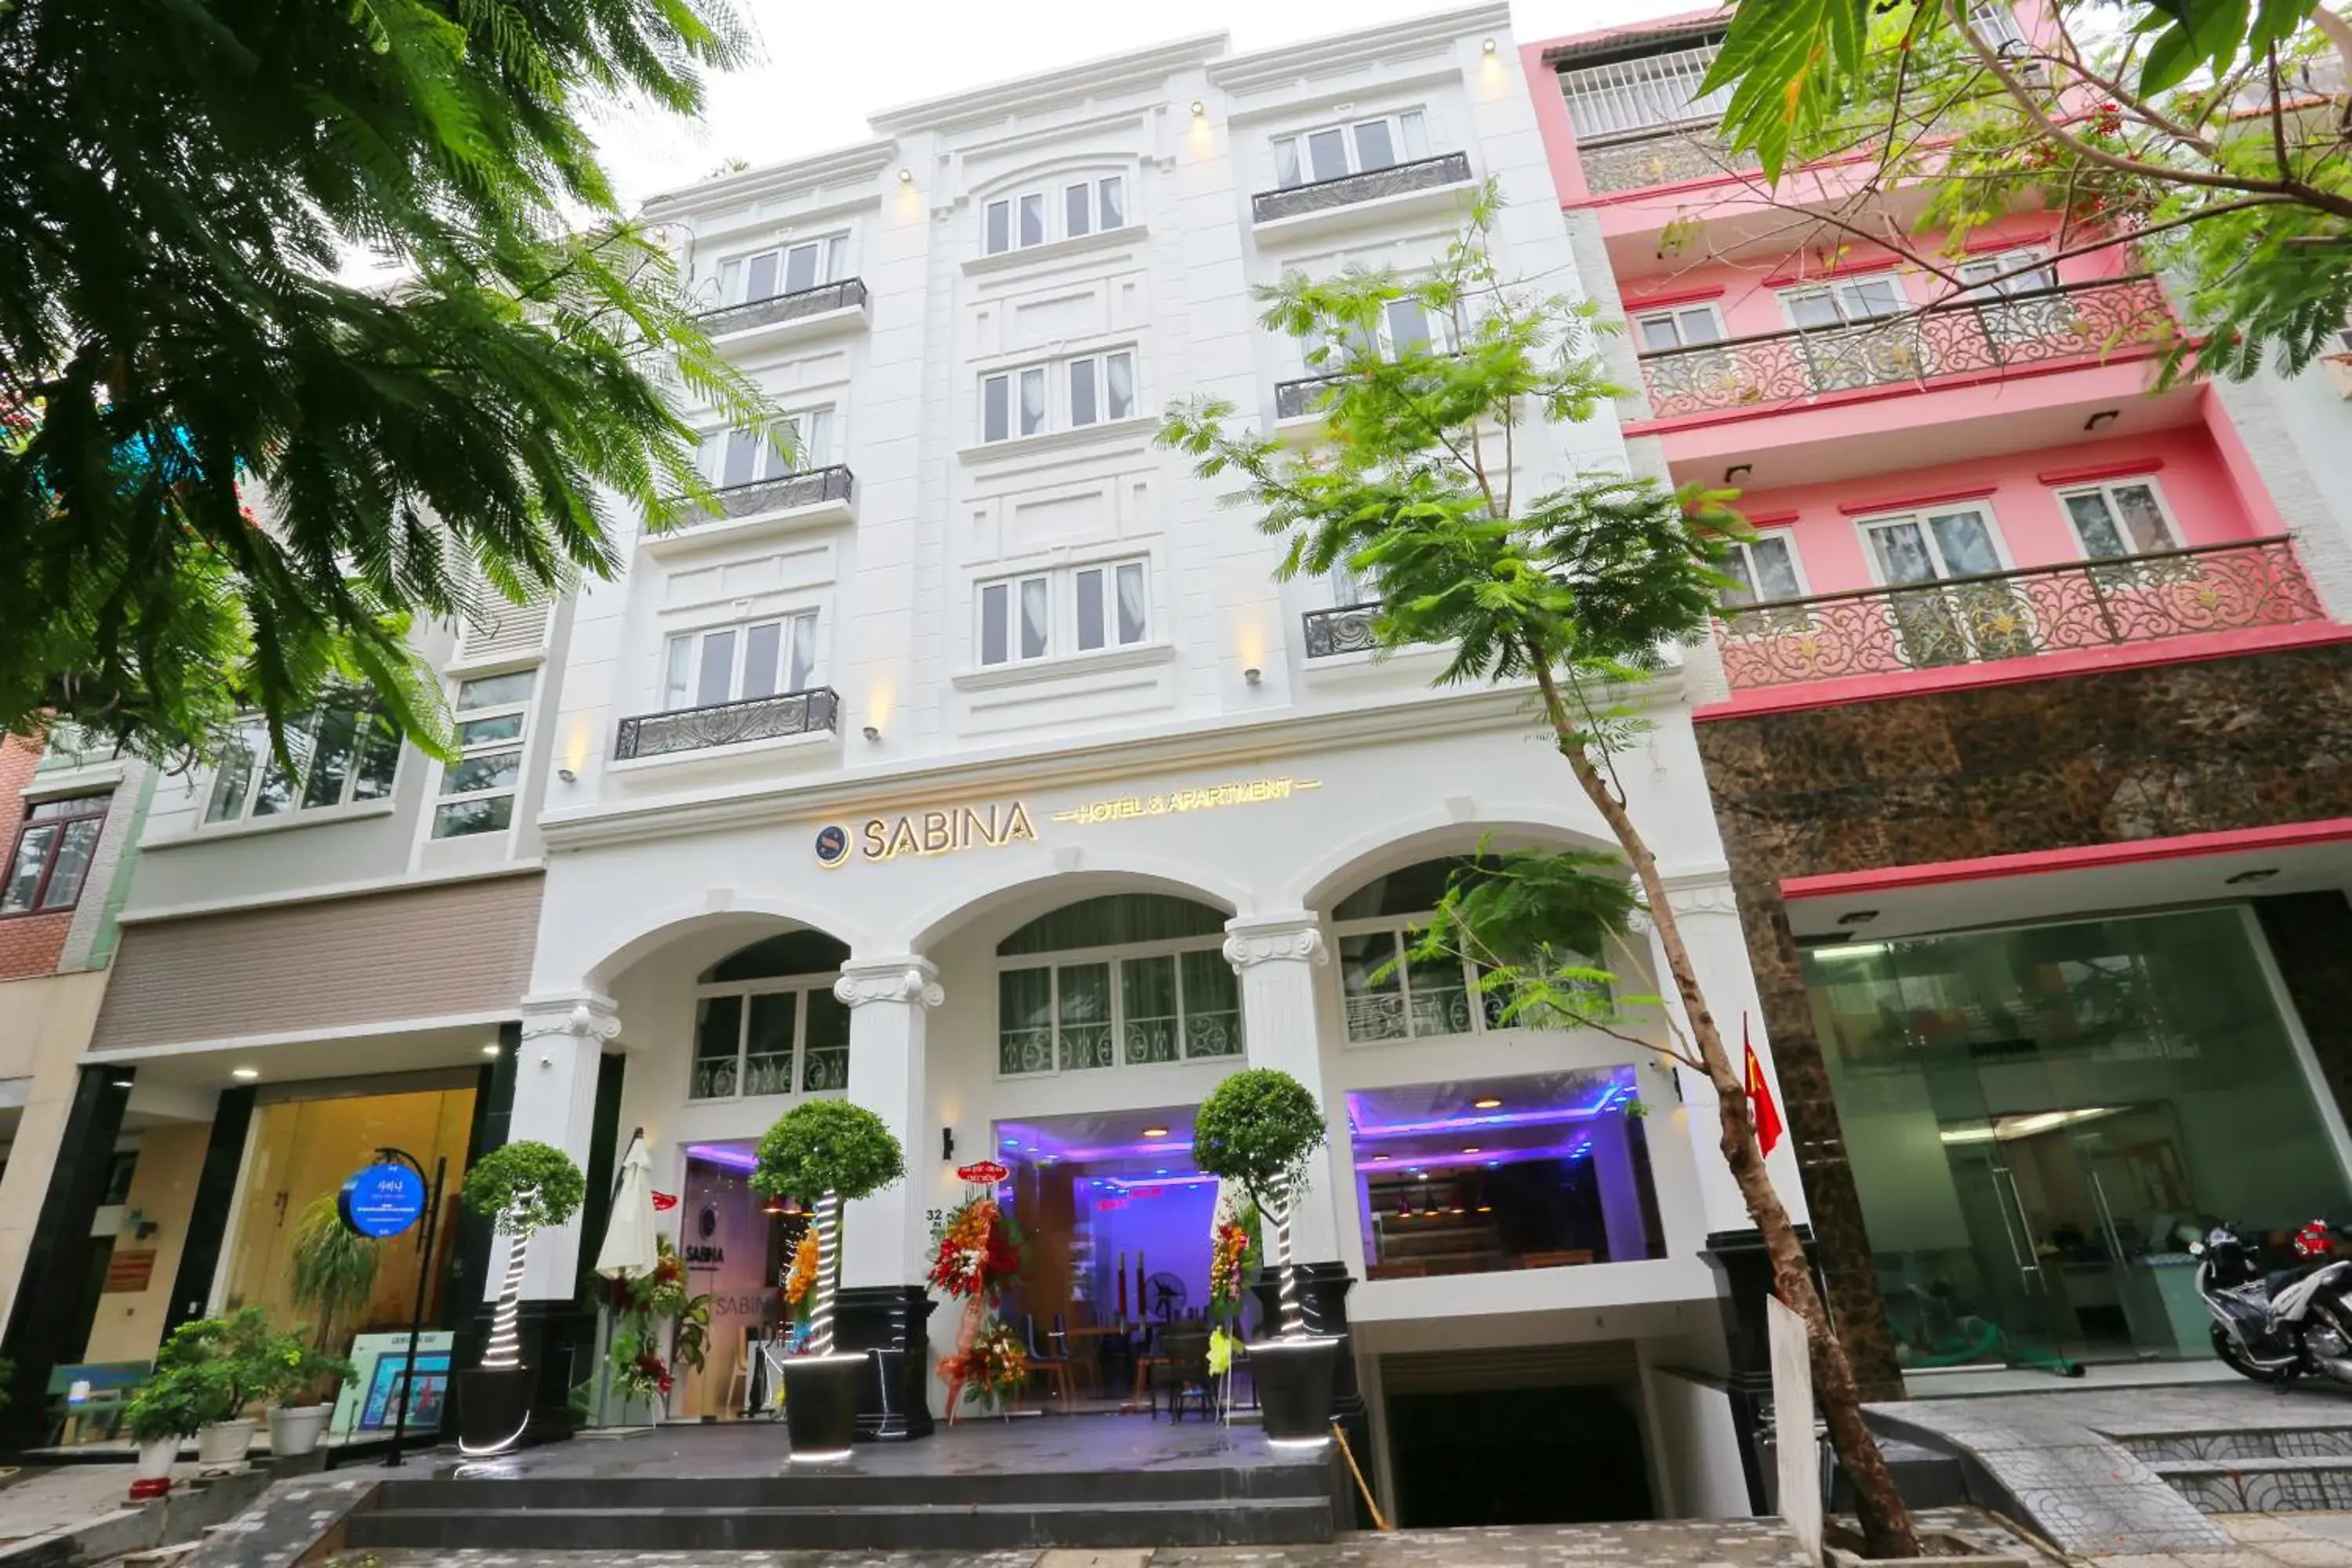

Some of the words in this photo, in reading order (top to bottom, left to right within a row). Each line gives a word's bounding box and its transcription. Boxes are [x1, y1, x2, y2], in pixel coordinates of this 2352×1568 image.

[1076, 798, 1145, 823] HOTEL
[1148, 794, 1165, 815] &
[1167, 779, 1293, 812] APARTMENT
[863, 801, 1037, 859] SABINA
[926, 1209, 942, 1221] 32
[716, 1295, 768, 1316] SABIN
